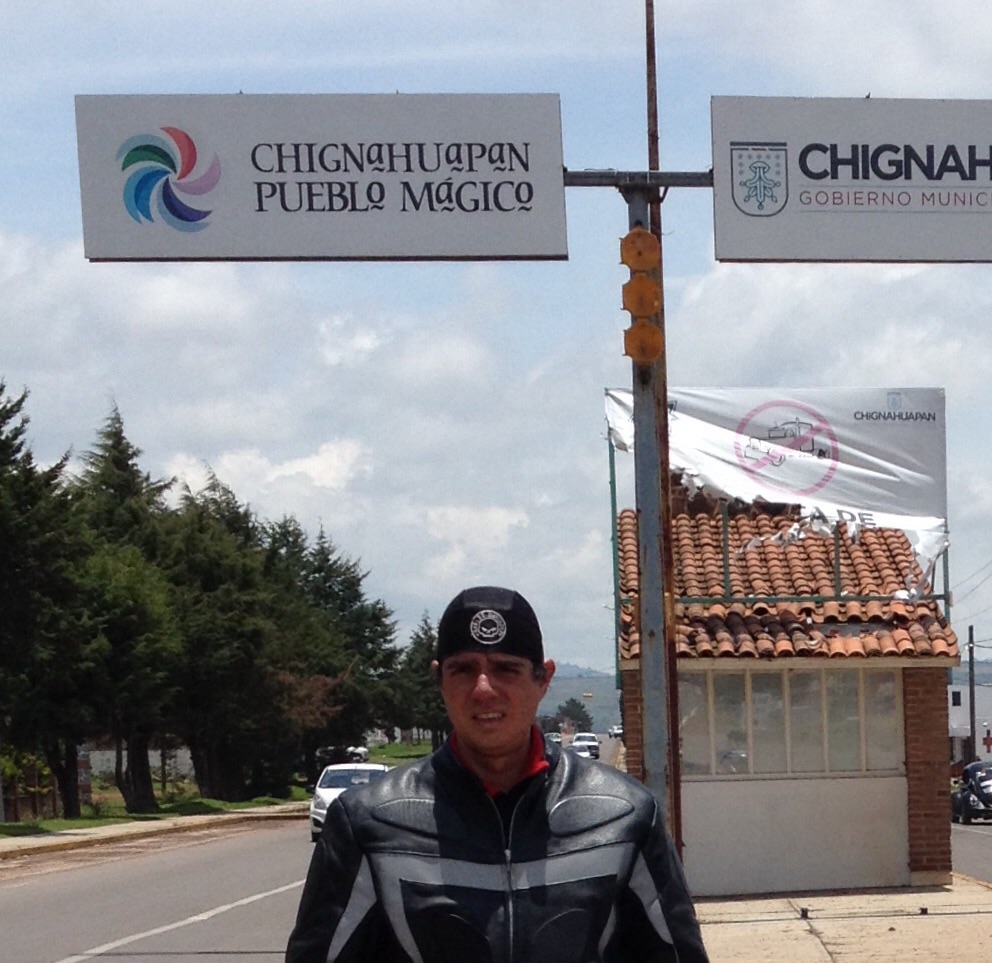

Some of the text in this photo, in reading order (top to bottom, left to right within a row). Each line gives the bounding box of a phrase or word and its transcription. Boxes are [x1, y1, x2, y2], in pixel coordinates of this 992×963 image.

[799, 190, 912, 207] GOBIERNO
[853, 410, 936, 421] CHIGNAHUAPAN
[836, 508, 876, 526] DE
